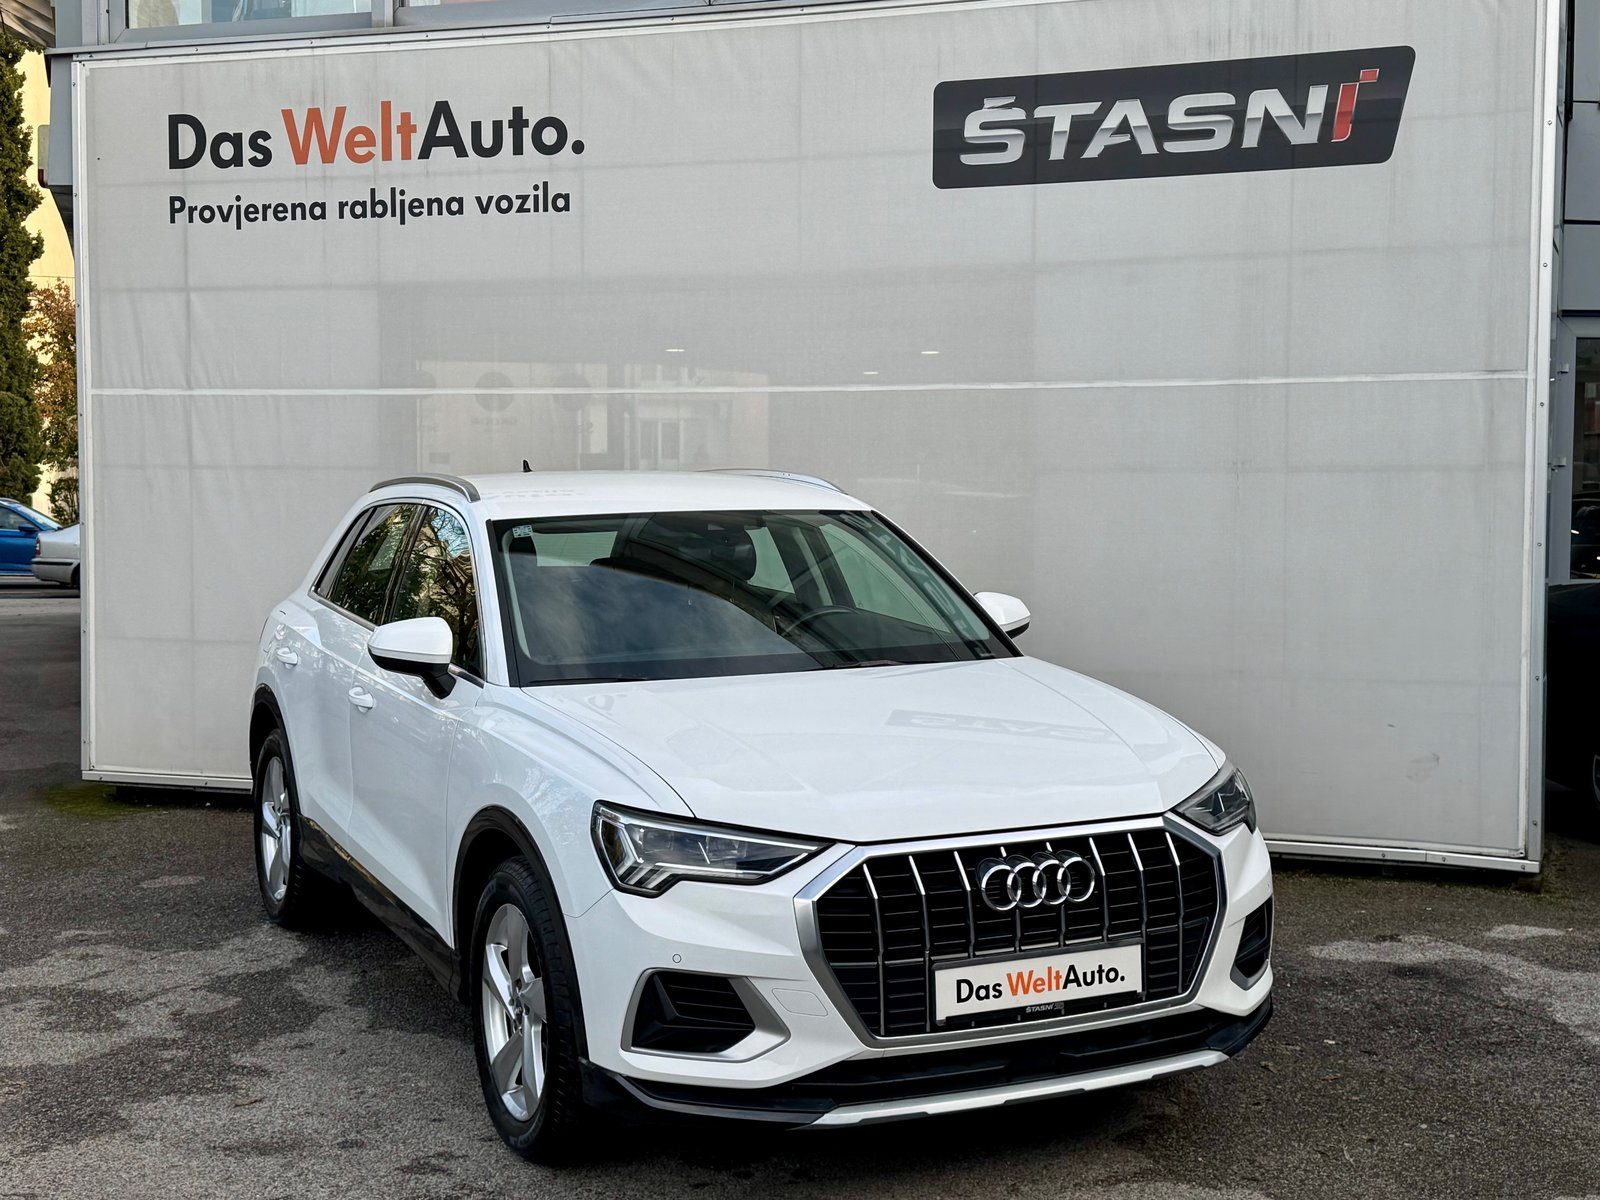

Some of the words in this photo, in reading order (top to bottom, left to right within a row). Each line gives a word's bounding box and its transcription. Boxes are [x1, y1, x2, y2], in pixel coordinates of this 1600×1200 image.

[167, 113, 273, 170] Das
[281, 100, 585, 165] WeltAuto.
[169, 194, 327, 231] Provjerena
[338, 186, 464, 226] rabljena
[474, 180, 571, 216] vozila
[956, 978, 1003, 1004] Das
[1006, 963, 1126, 997] WeltAuto.
